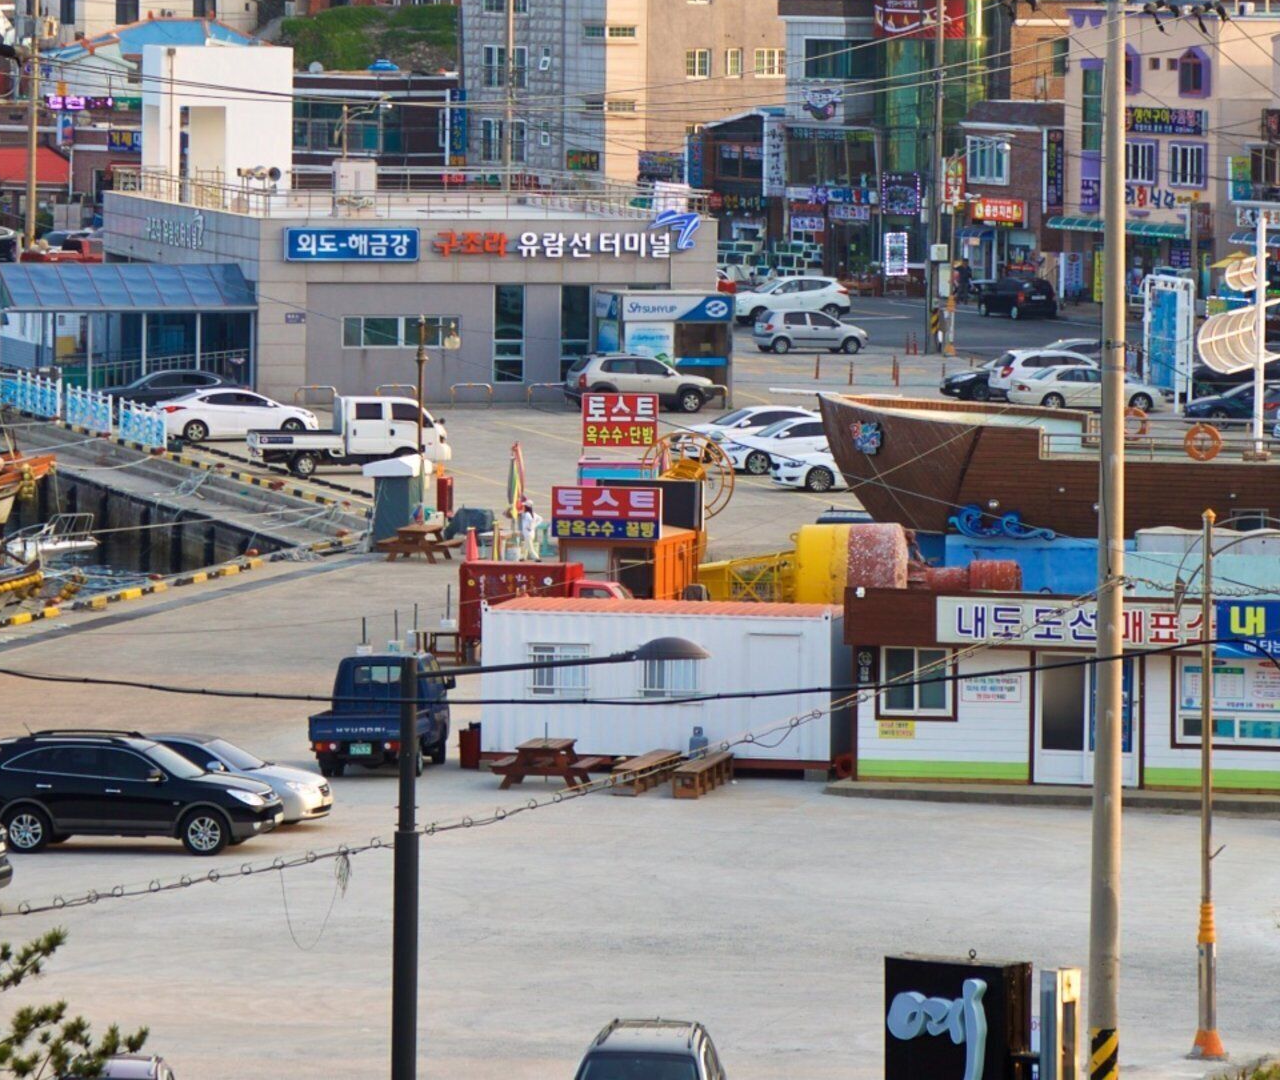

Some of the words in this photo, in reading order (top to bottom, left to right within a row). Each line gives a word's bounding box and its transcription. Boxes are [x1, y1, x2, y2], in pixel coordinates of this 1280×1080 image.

[296, 234, 410, 257] 외도-해금강
[433, 231, 509, 258] 구조라
[517, 231, 593, 259] 유람선
[599, 231, 671, 259] 터미널
[586, 396, 655, 422] 토스트
[556, 489, 655, 517] 토스트
